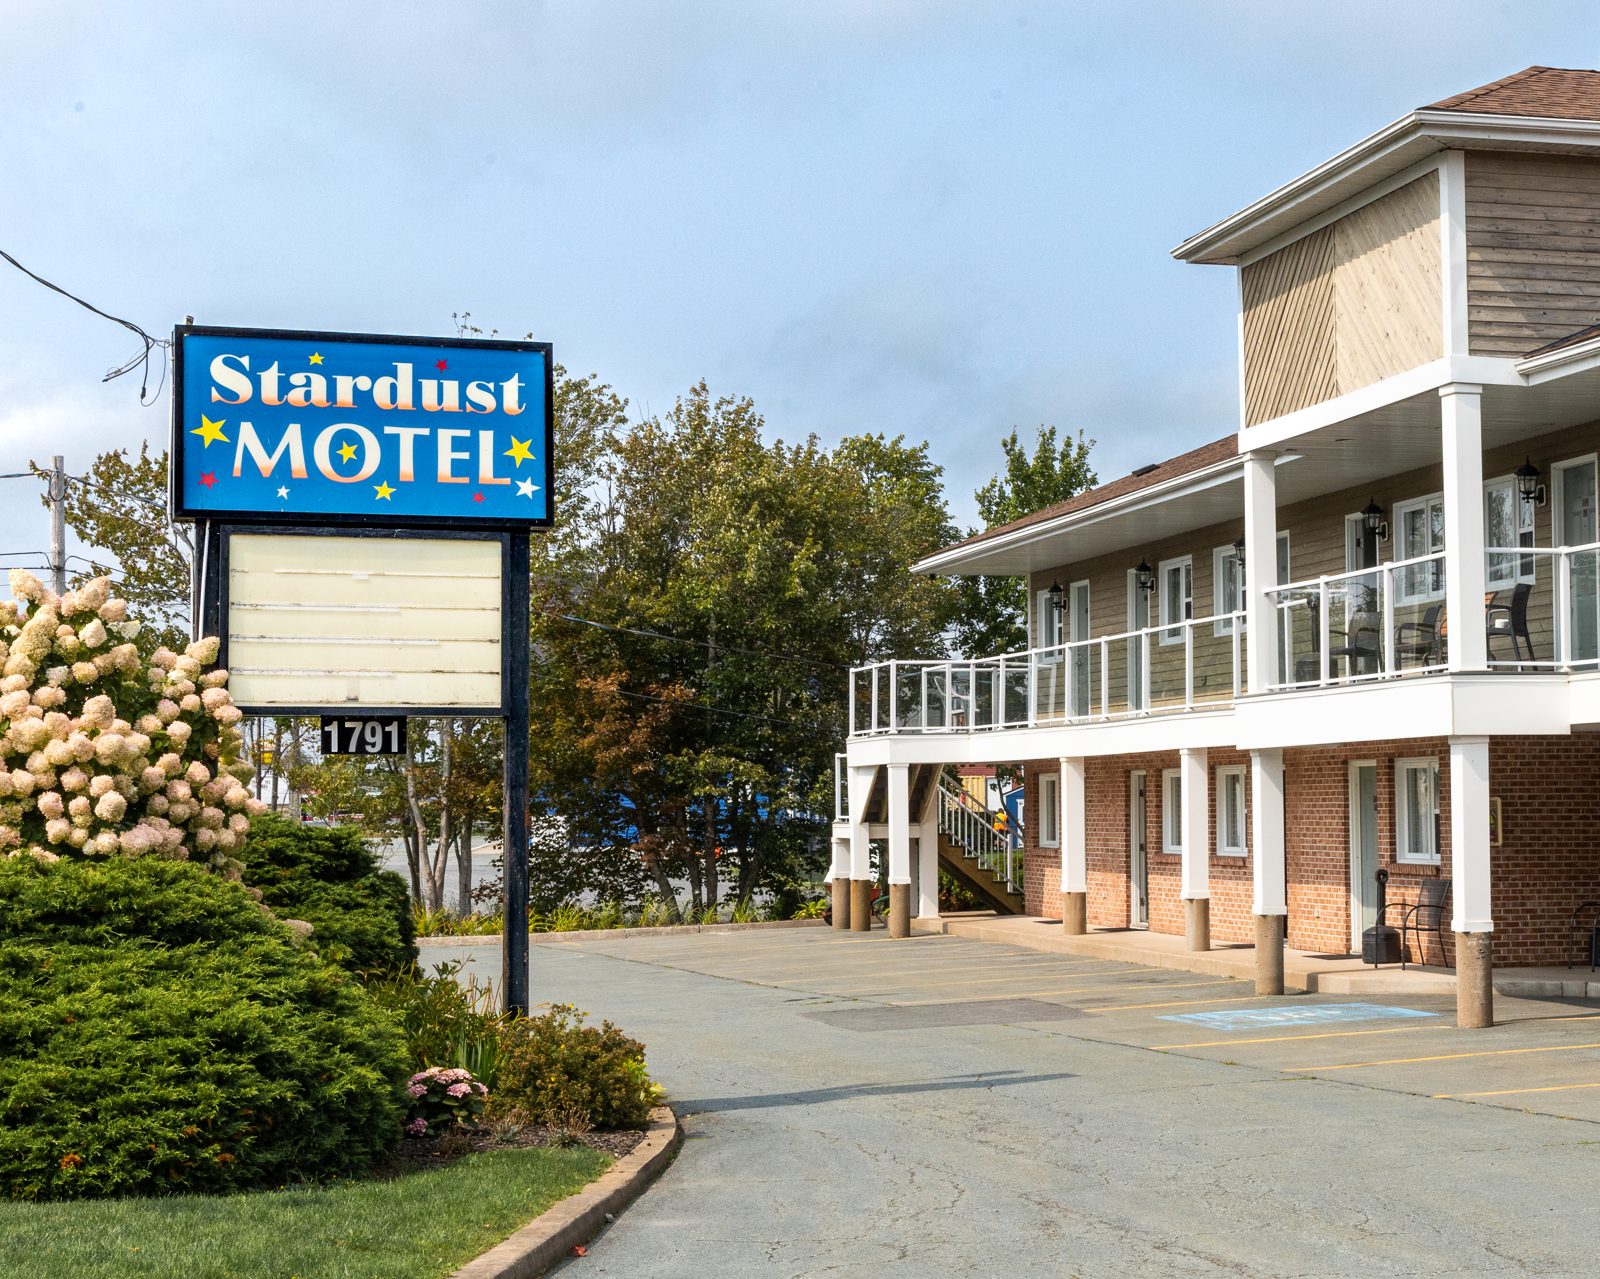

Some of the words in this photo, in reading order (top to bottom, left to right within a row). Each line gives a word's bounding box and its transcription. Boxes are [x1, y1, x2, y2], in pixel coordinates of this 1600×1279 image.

[209, 354, 526, 415] Stardust
[232, 421, 512, 485] MOTEL
[324, 720, 399, 753] 1791
